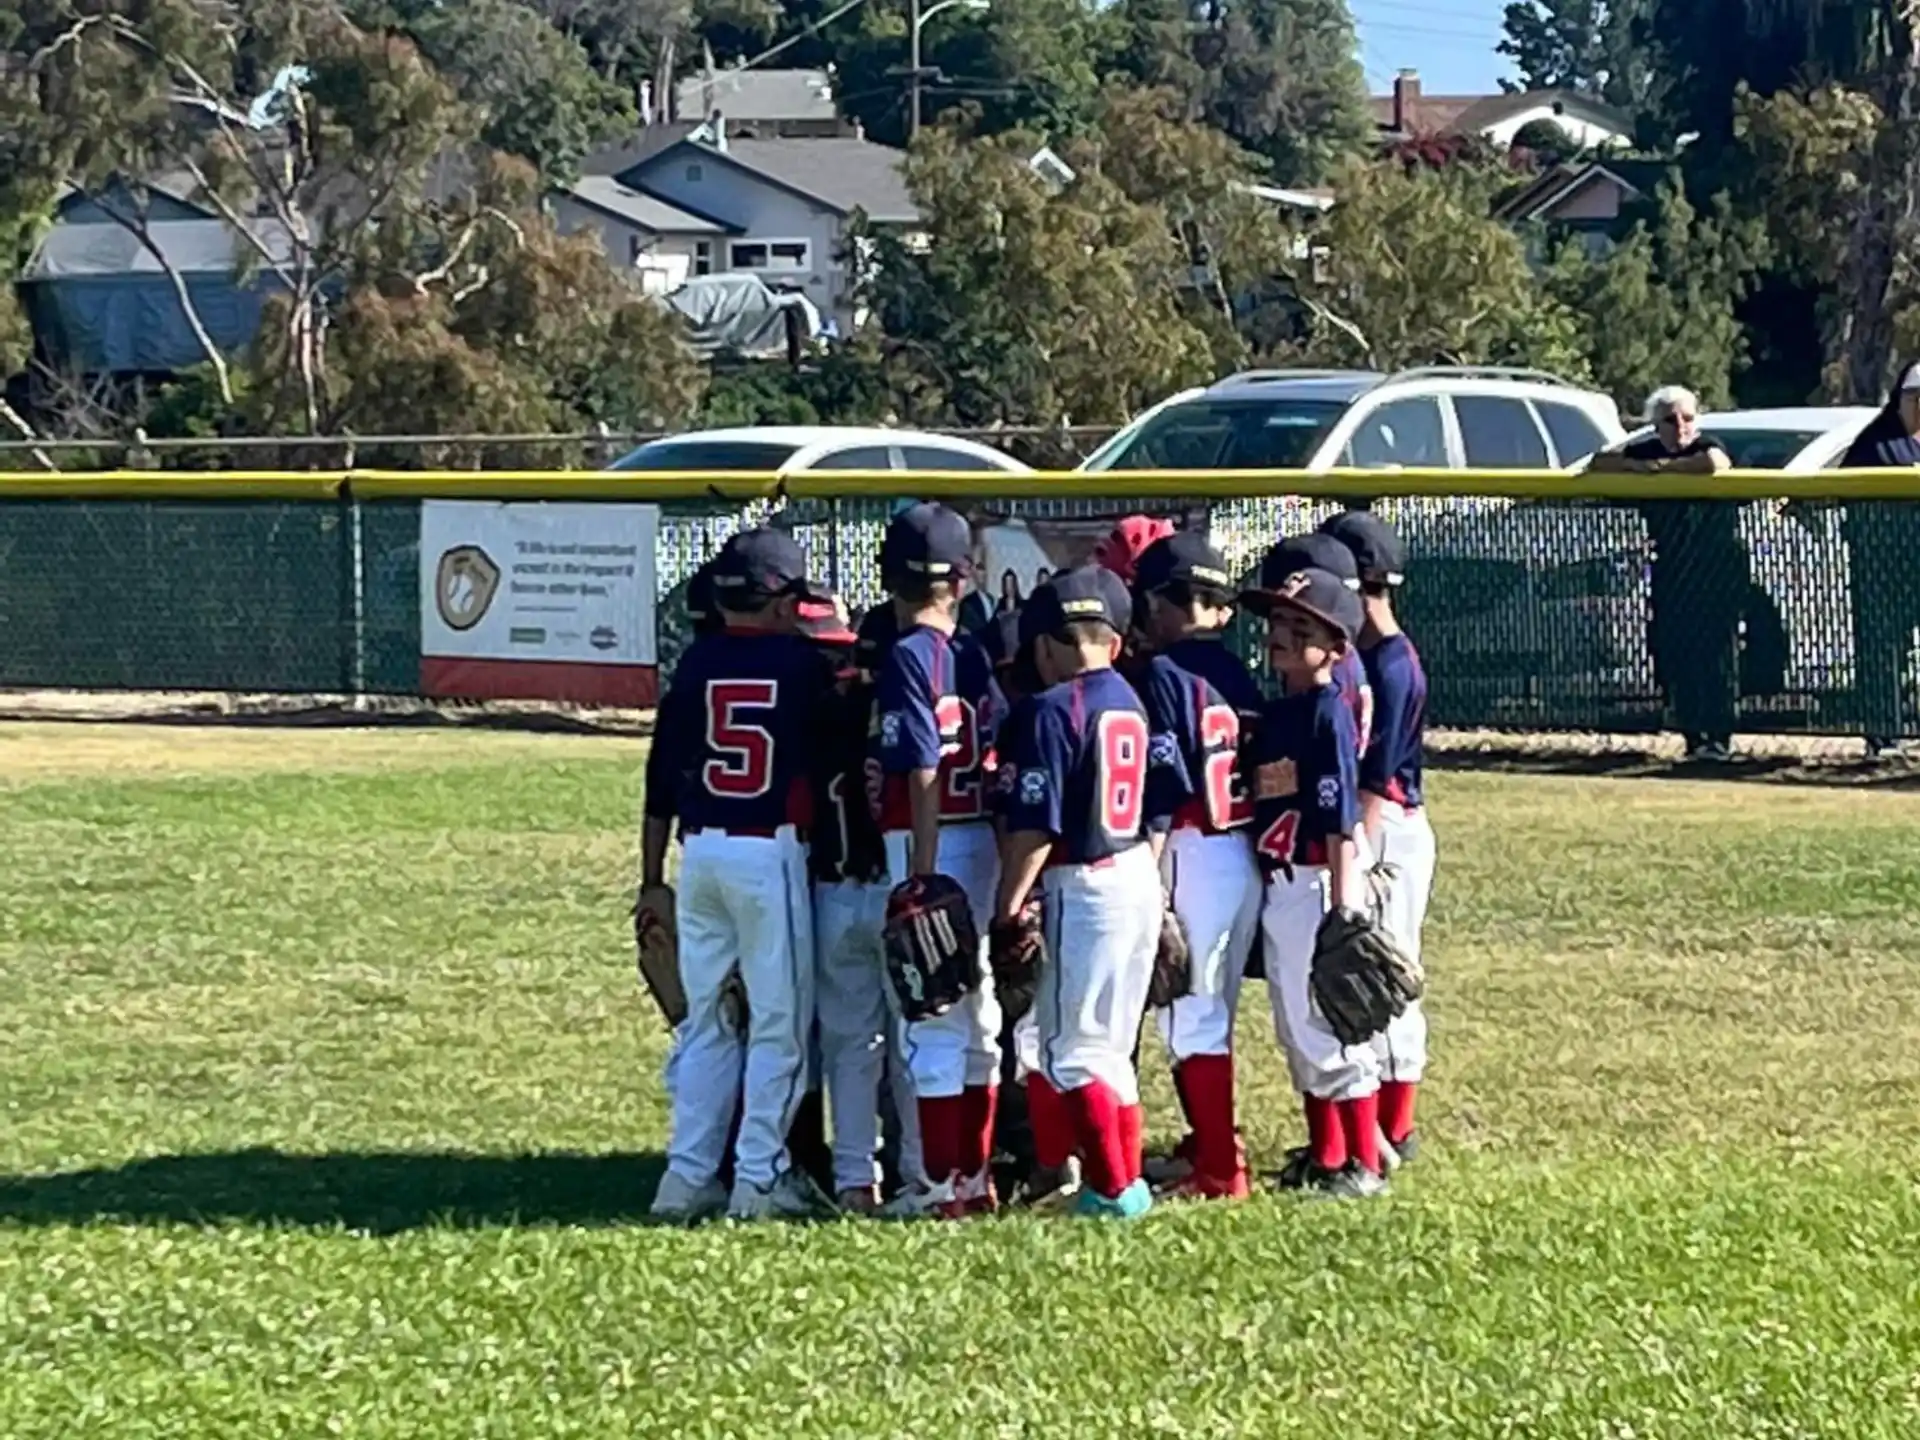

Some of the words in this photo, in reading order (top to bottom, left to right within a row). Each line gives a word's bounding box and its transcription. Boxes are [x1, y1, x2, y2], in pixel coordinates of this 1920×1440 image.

[703, 679, 778, 798] 5
[1098, 710, 1149, 838] 8
[1257, 809, 1300, 862] 4
